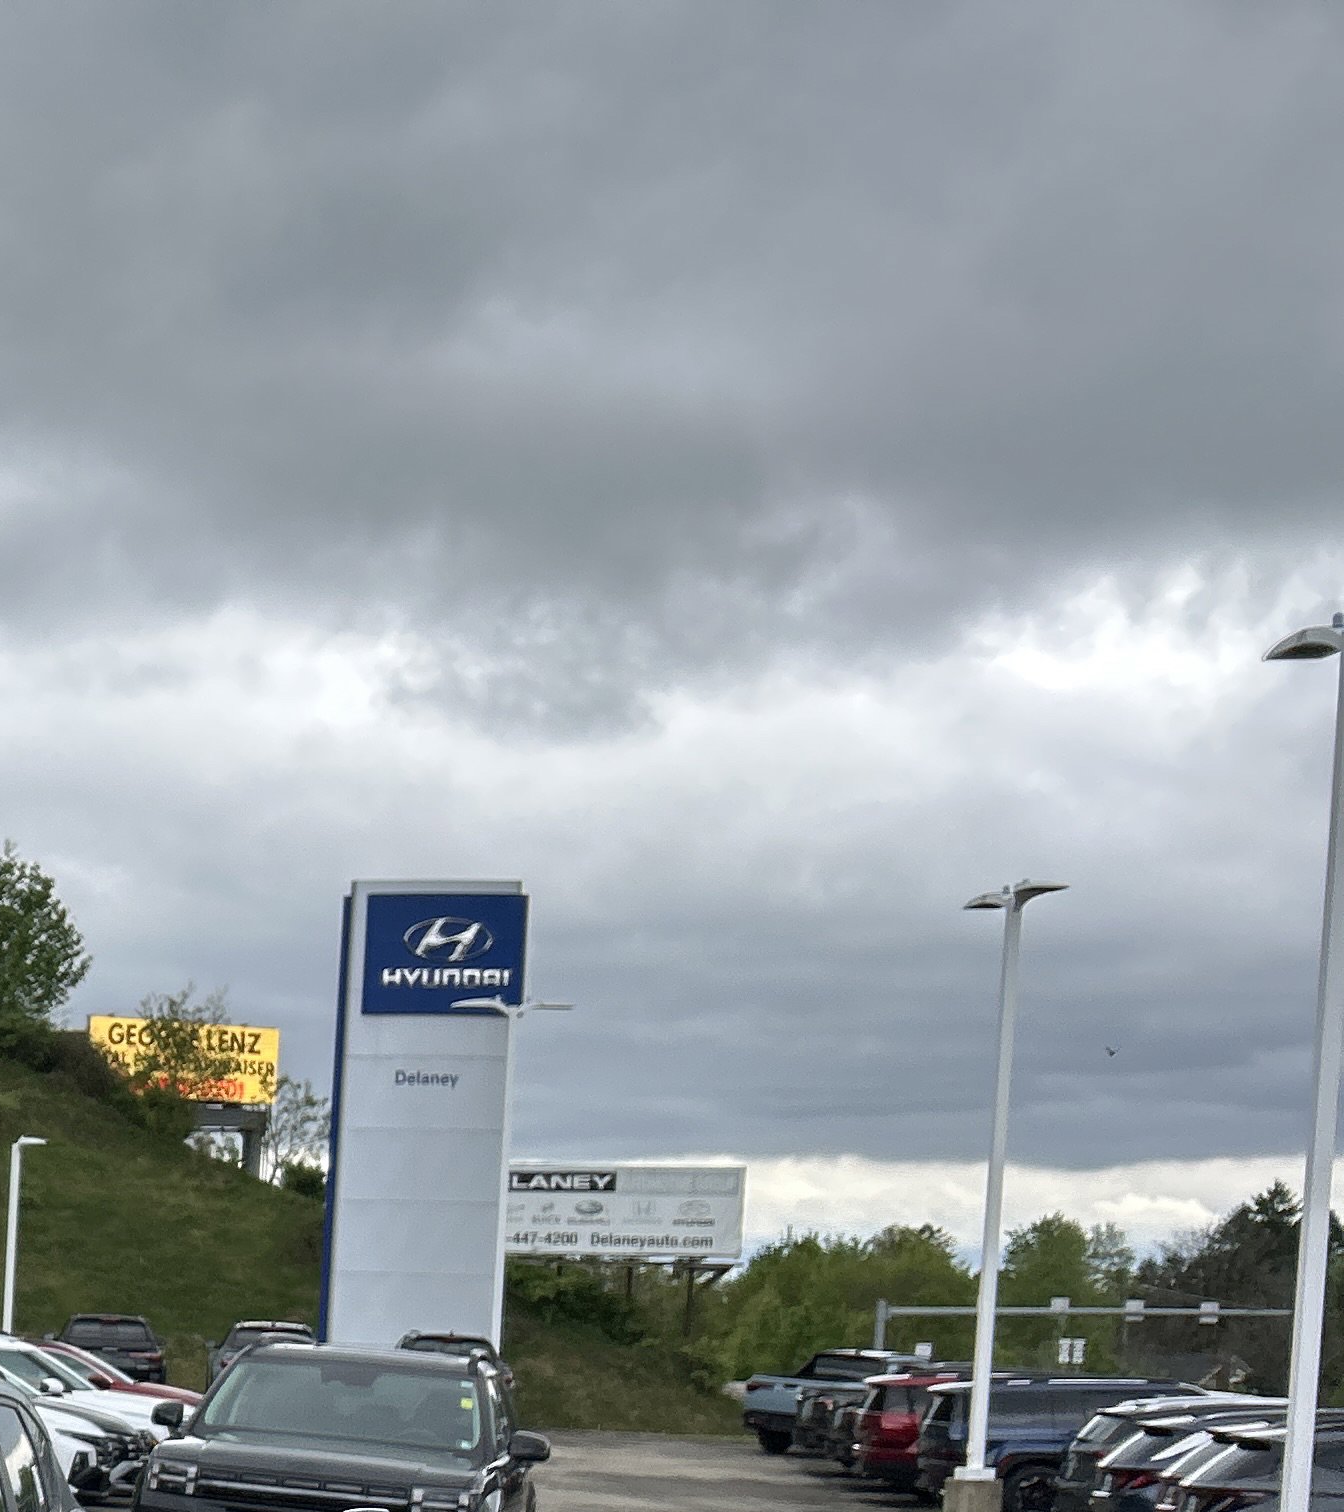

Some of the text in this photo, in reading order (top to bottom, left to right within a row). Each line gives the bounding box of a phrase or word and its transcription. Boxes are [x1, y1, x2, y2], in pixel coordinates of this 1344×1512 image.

[382, 968, 510, 986] HYUNDAI
[206, 1029, 261, 1054] LENZ
[395, 1070, 459, 1088] Delaney
[513, 1174, 612, 1190] LANEY
